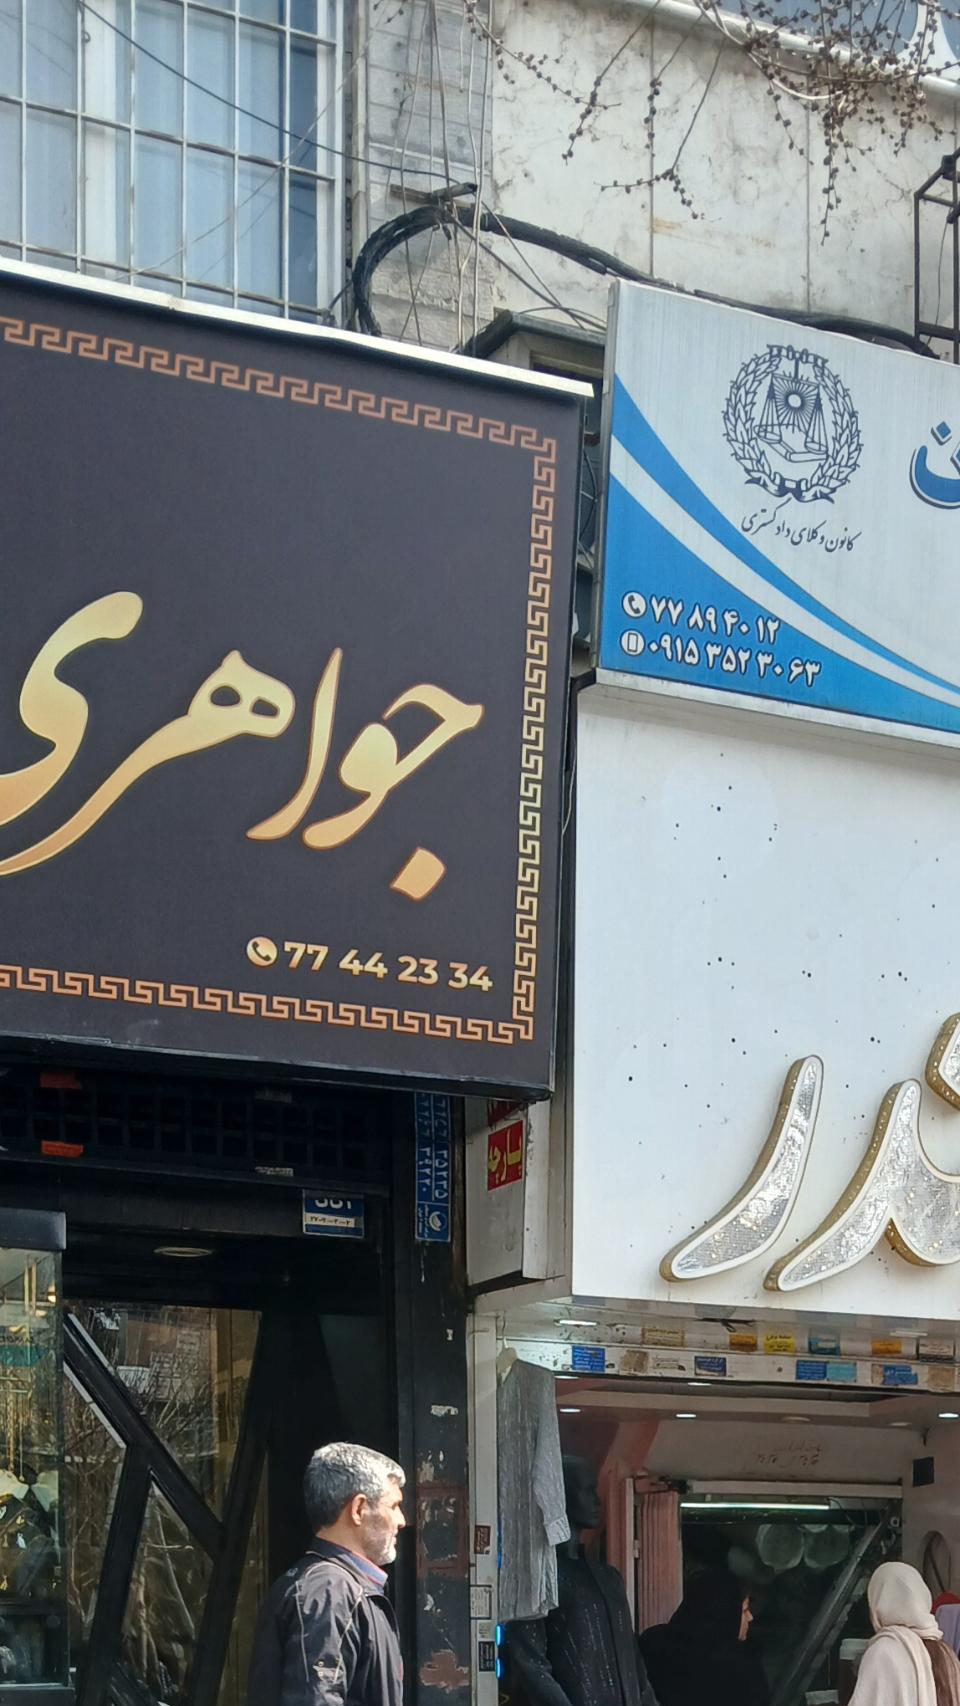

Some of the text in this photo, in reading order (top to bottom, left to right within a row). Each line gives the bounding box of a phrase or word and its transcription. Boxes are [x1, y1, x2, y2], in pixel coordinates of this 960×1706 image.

[824, 526, 862, 553] کانون
[650, 595, 781, 645] ۷۷ ۸۹ ۴۰ ۱۲
[648, 633, 701, 667] ۰۹۱۵
[755, 650, 785, 680] ۳۰
[787, 657, 822, 688] ۶۳
[0, 590, 485, 902] جواهری
[284, 940, 494, 993] 77 44 23 34
